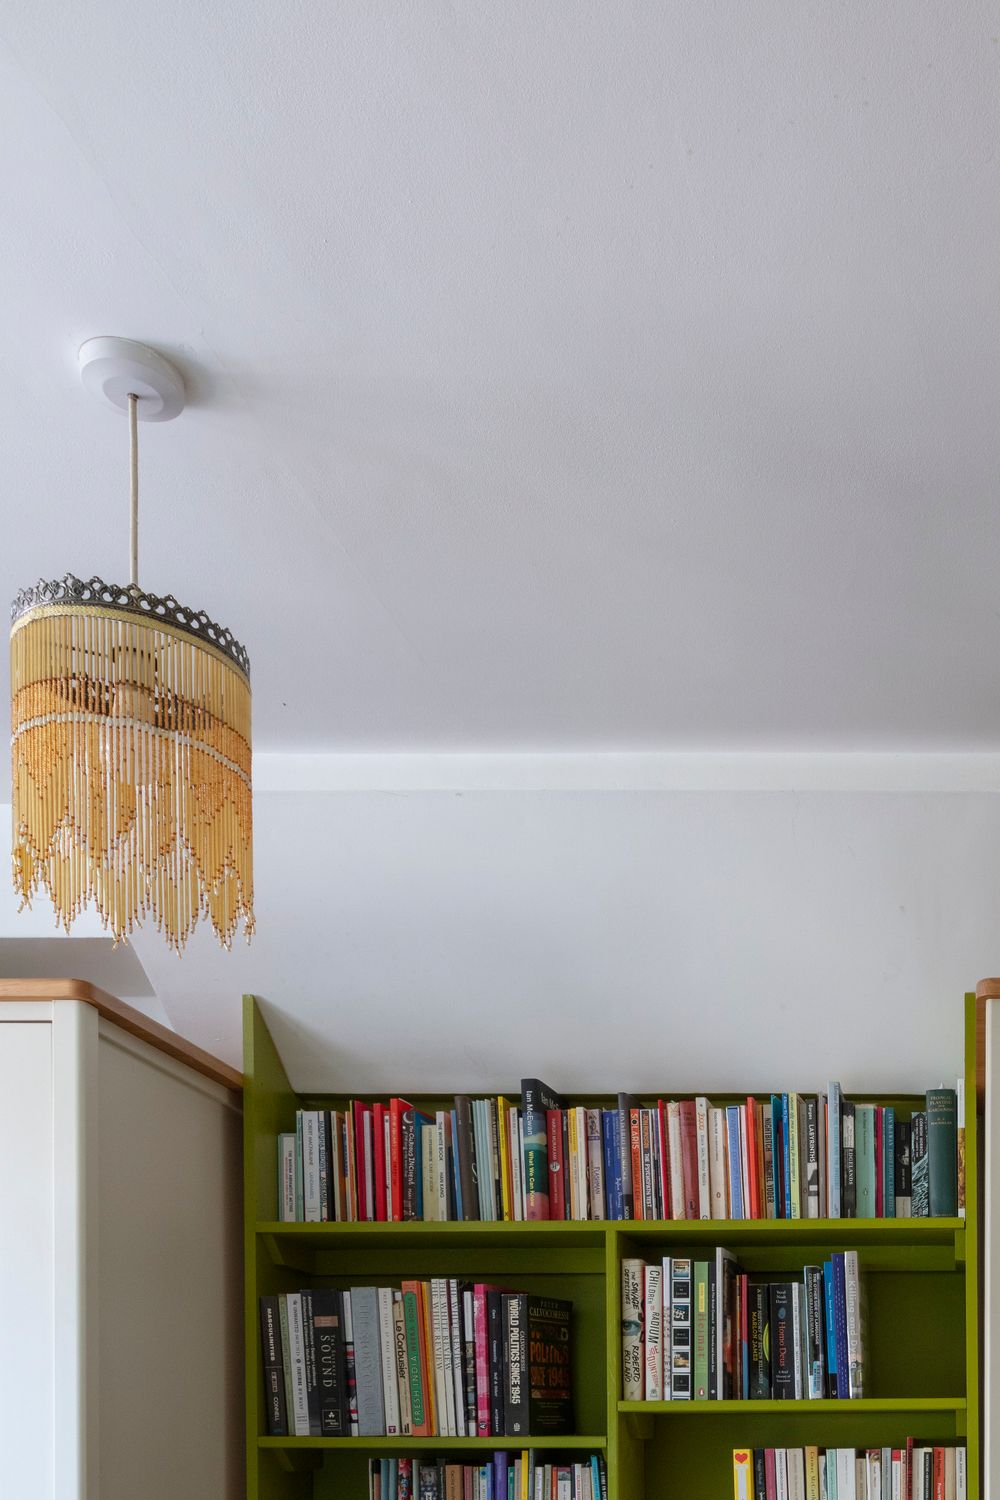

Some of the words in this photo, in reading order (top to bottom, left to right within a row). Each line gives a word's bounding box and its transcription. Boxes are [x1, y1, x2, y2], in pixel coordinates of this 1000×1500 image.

[630, 1113, 639, 1150] SOLARIS
[530, 1167, 534, 1176] We
[630, 1282, 640, 1310] SAVAGE
[648, 1270, 660, 1304] CHILDREN
[848, 1280, 856, 1312] Killing
[396, 1320, 404, 1332] Le
[432, 1302, 440, 1332] WHITE
[510, 1299, 519, 1326] WORLD
[529, 1307, 569, 1320] CALVOCORESSI
[648, 1312, 660, 1344] RADIUM
[267, 1308, 276, 1361] MASCULINITIES
[510, 1328, 520, 1360] POLITICS
[320, 1335, 332, 1388] SOUND
[396, 1333, 406, 1379] Corbusier
[434, 1336, 443, 1371] REVIEW
[442, 1336, 450, 1371] REVIEW
[632, 1346, 640, 1382] ROBERTO
[410, 1356, 419, 1386] INDIA
[511, 1362, 520, 1384] SINCE
[412, 1390, 422, 1420] FRESH
[512, 1386, 520, 1404] 1945
